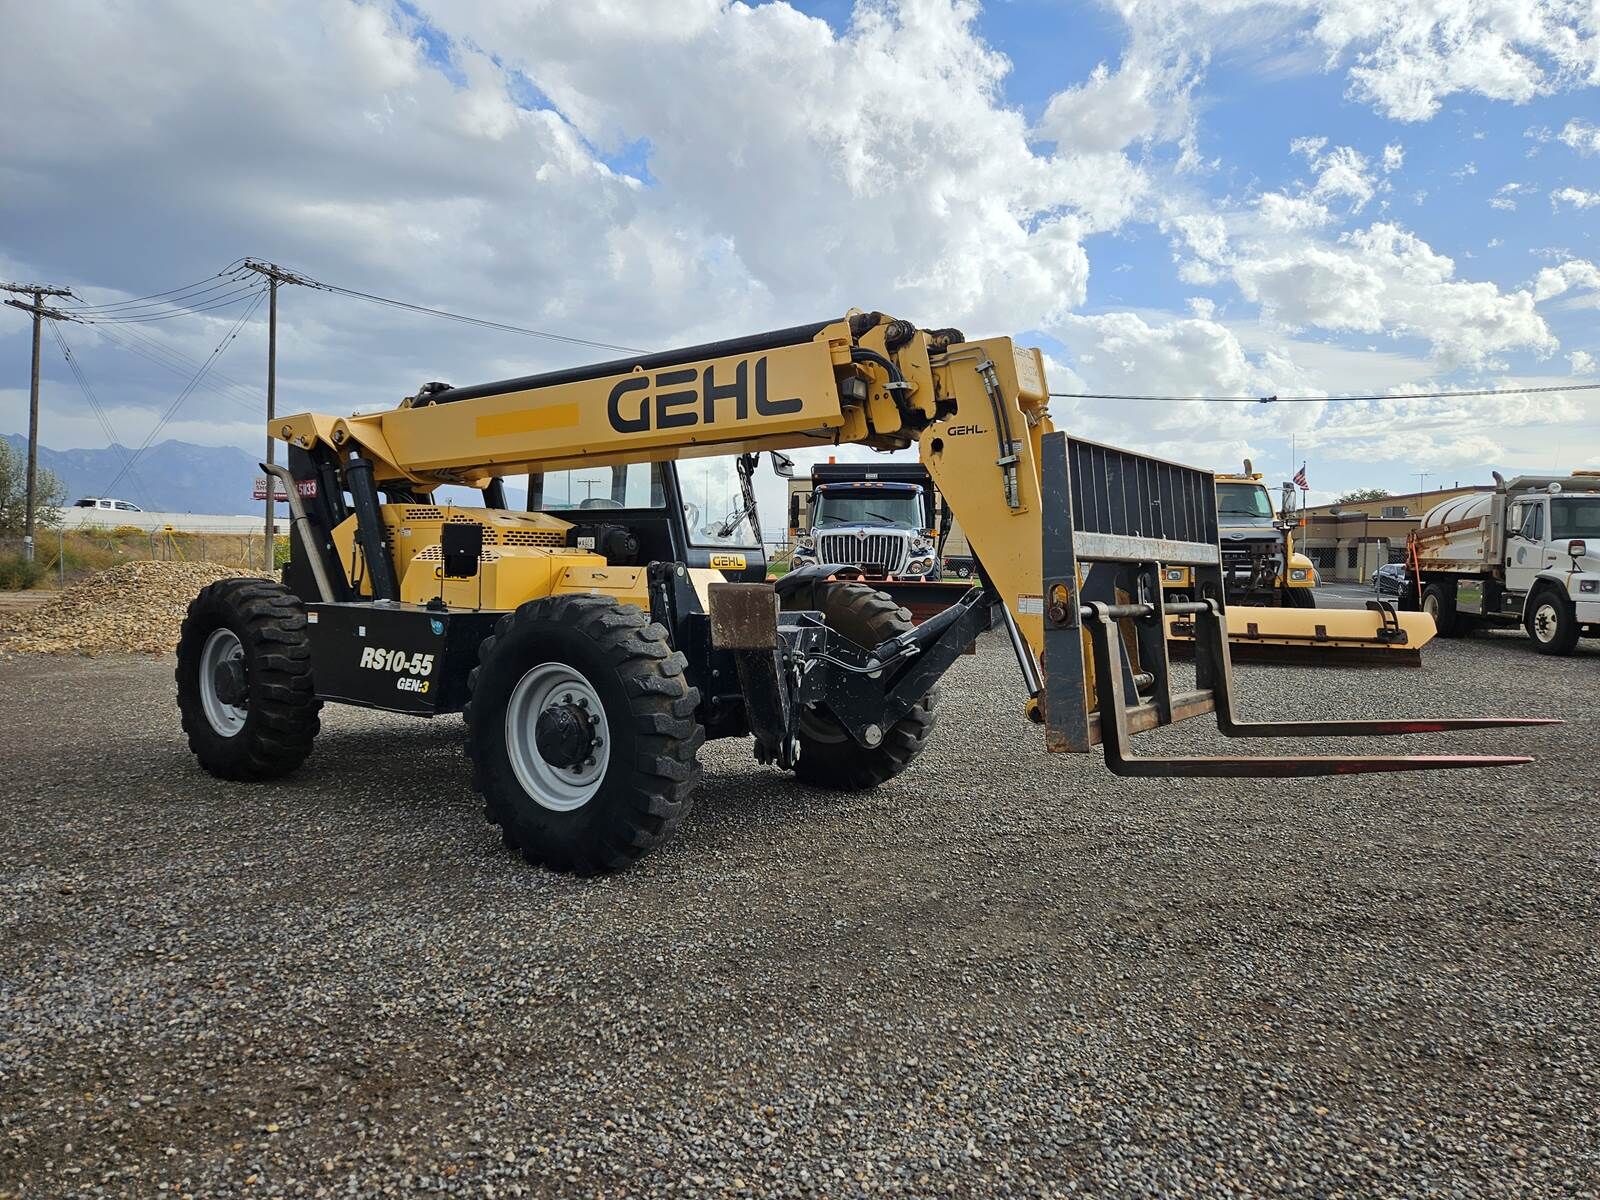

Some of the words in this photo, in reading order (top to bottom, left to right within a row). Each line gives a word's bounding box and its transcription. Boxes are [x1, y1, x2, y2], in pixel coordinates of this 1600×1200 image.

[607, 356, 803, 433] GEHL
[947, 425, 983, 436] GEHL
[713, 556, 743, 566] GEHL
[360, 646, 435, 676] RS10-55
[396, 677, 430, 693] GEN:3
